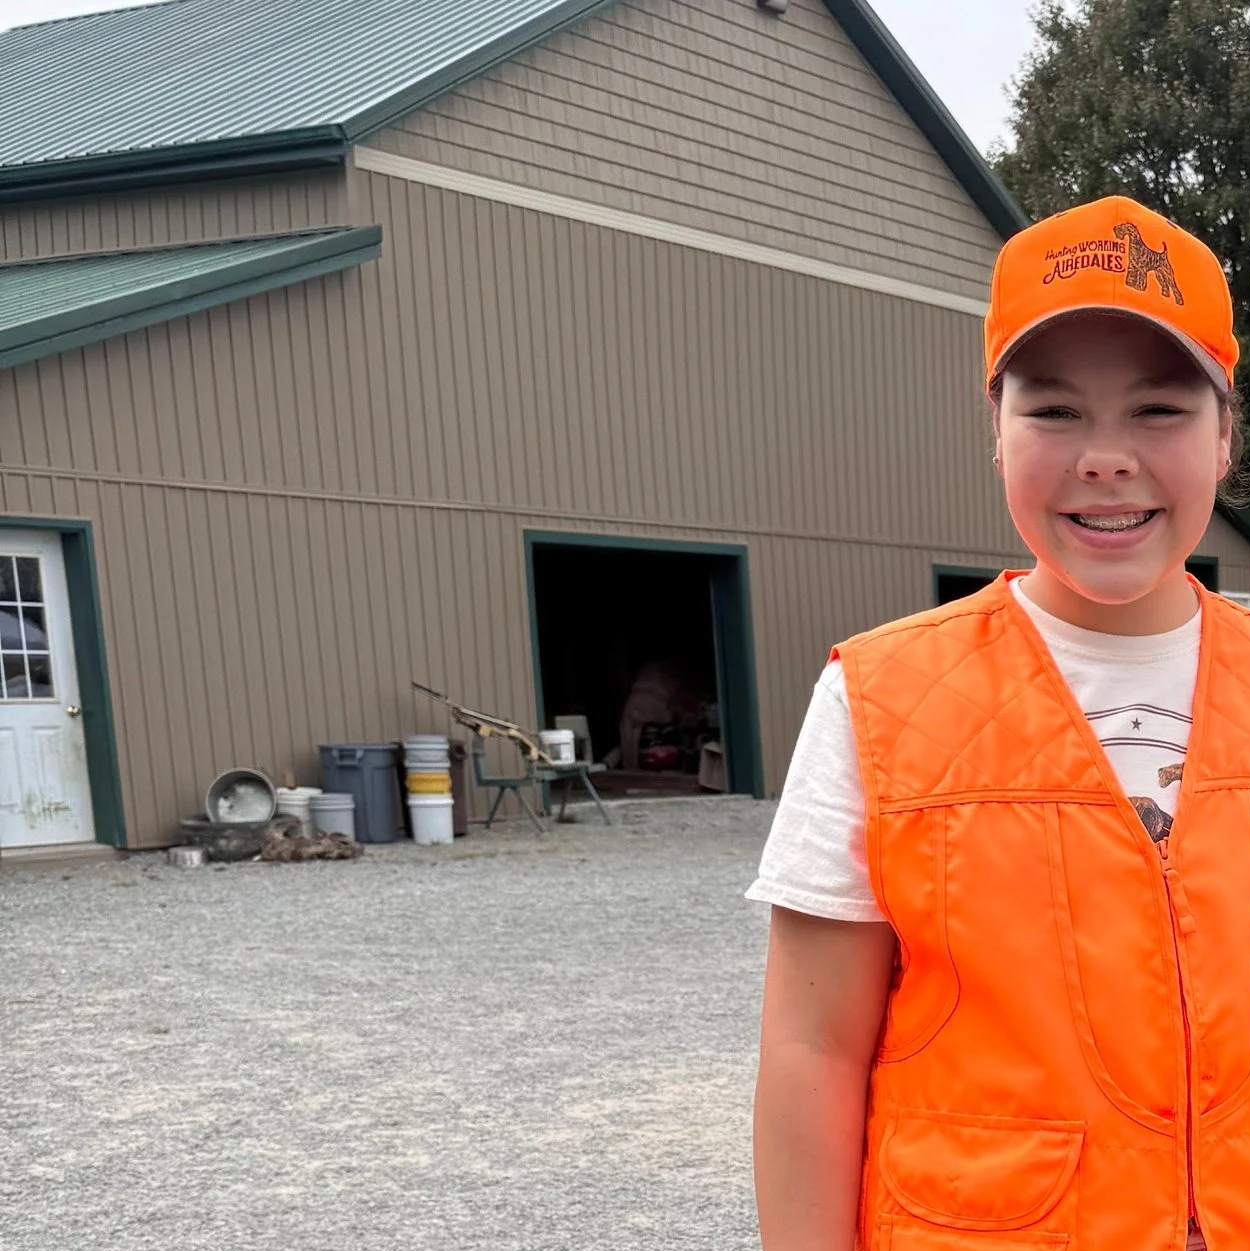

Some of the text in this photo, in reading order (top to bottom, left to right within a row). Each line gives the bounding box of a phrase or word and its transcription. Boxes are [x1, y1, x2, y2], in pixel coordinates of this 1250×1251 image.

[1045, 240, 1126, 260] Hunting WORKING
[1042, 253, 1126, 285] AIREDALES
